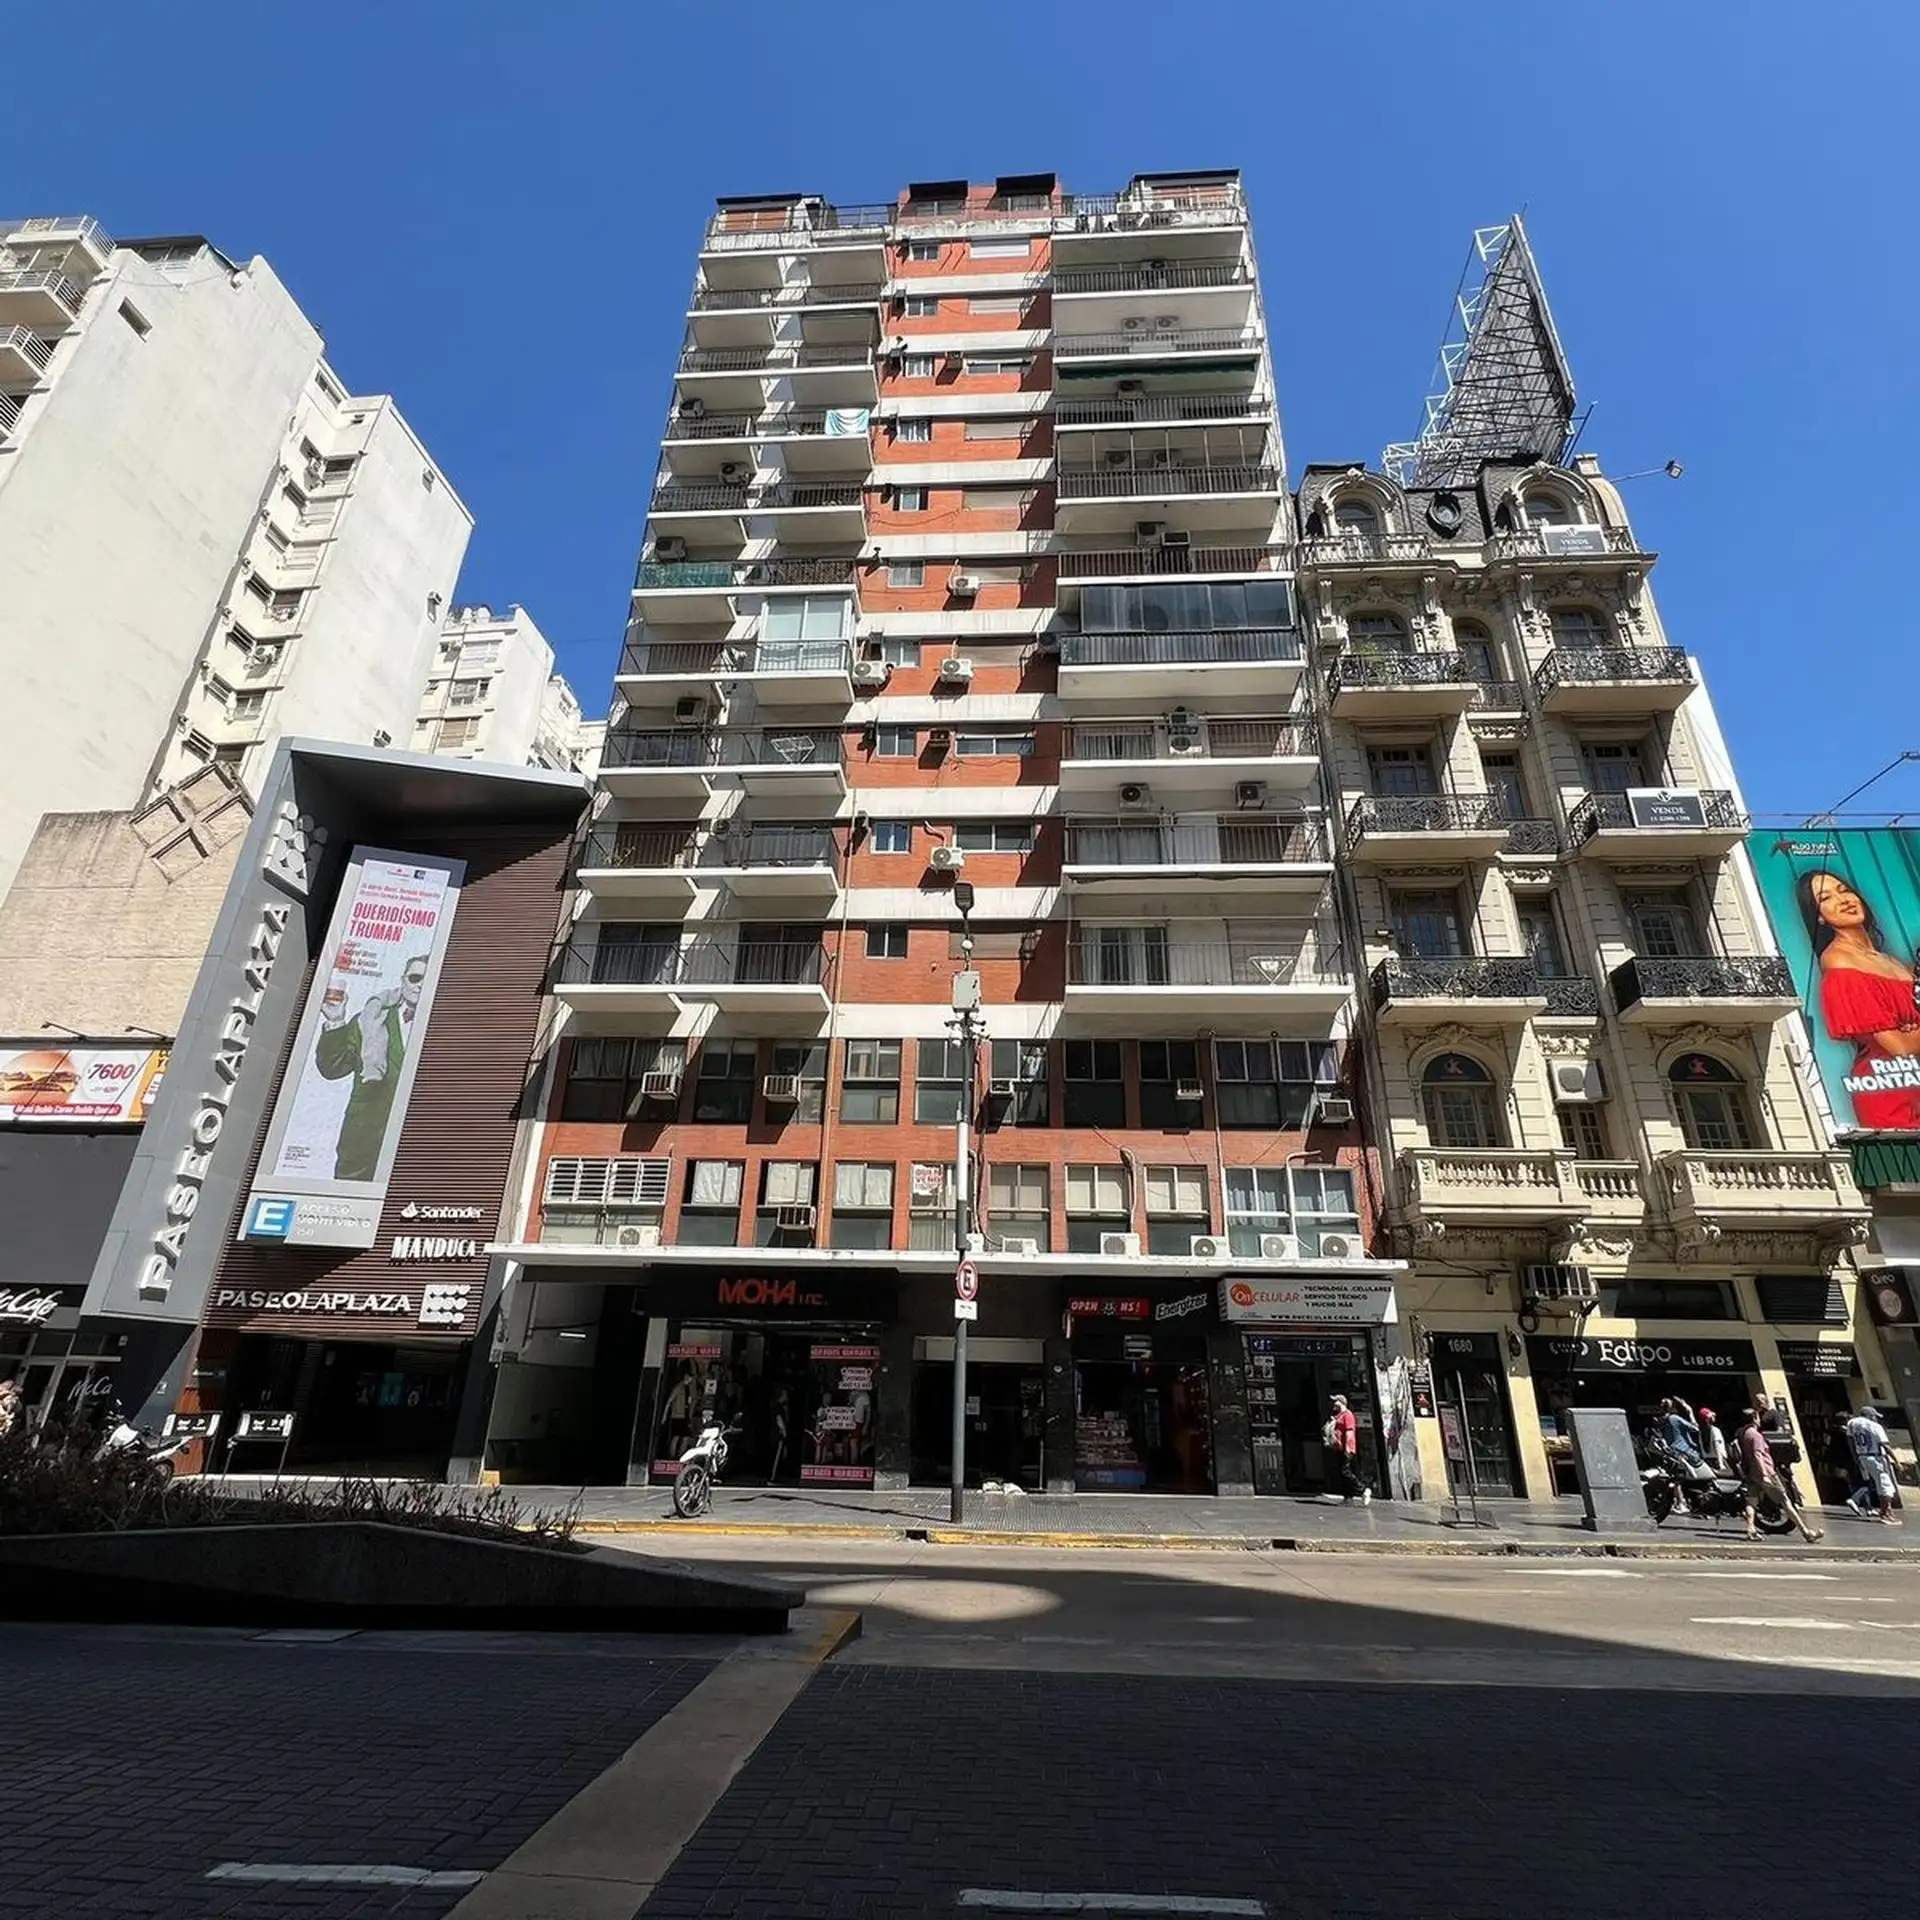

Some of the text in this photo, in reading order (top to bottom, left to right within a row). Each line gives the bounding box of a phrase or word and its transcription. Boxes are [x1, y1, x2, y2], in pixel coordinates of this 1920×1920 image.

[1651, 806, 1685, 814] VENDE
[353, 902, 437, 928] QUERIDÍSIMO
[349, 920, 404, 942] TRUMAN
[1870, 1054, 1919, 1074] Rubi
[1843, 1071, 1920, 1092] MONTA
[253, 1202, 289, 1231] E
[420, 1206, 485, 1219] Santander
[391, 1236, 476, 1258] MANDUCA
[718, 1278, 796, 1305] MOHA
[1254, 1291, 1301, 1303] CELULAR
[1071, 1301, 1098, 1312] OPEN
[1156, 1294, 1207, 1320] Energizer
[1448, 1339, 1473, 1353] 1680
[1597, 1340, 1672, 1368] Edipo
[1682, 1355, 1734, 1367] LIBROS
